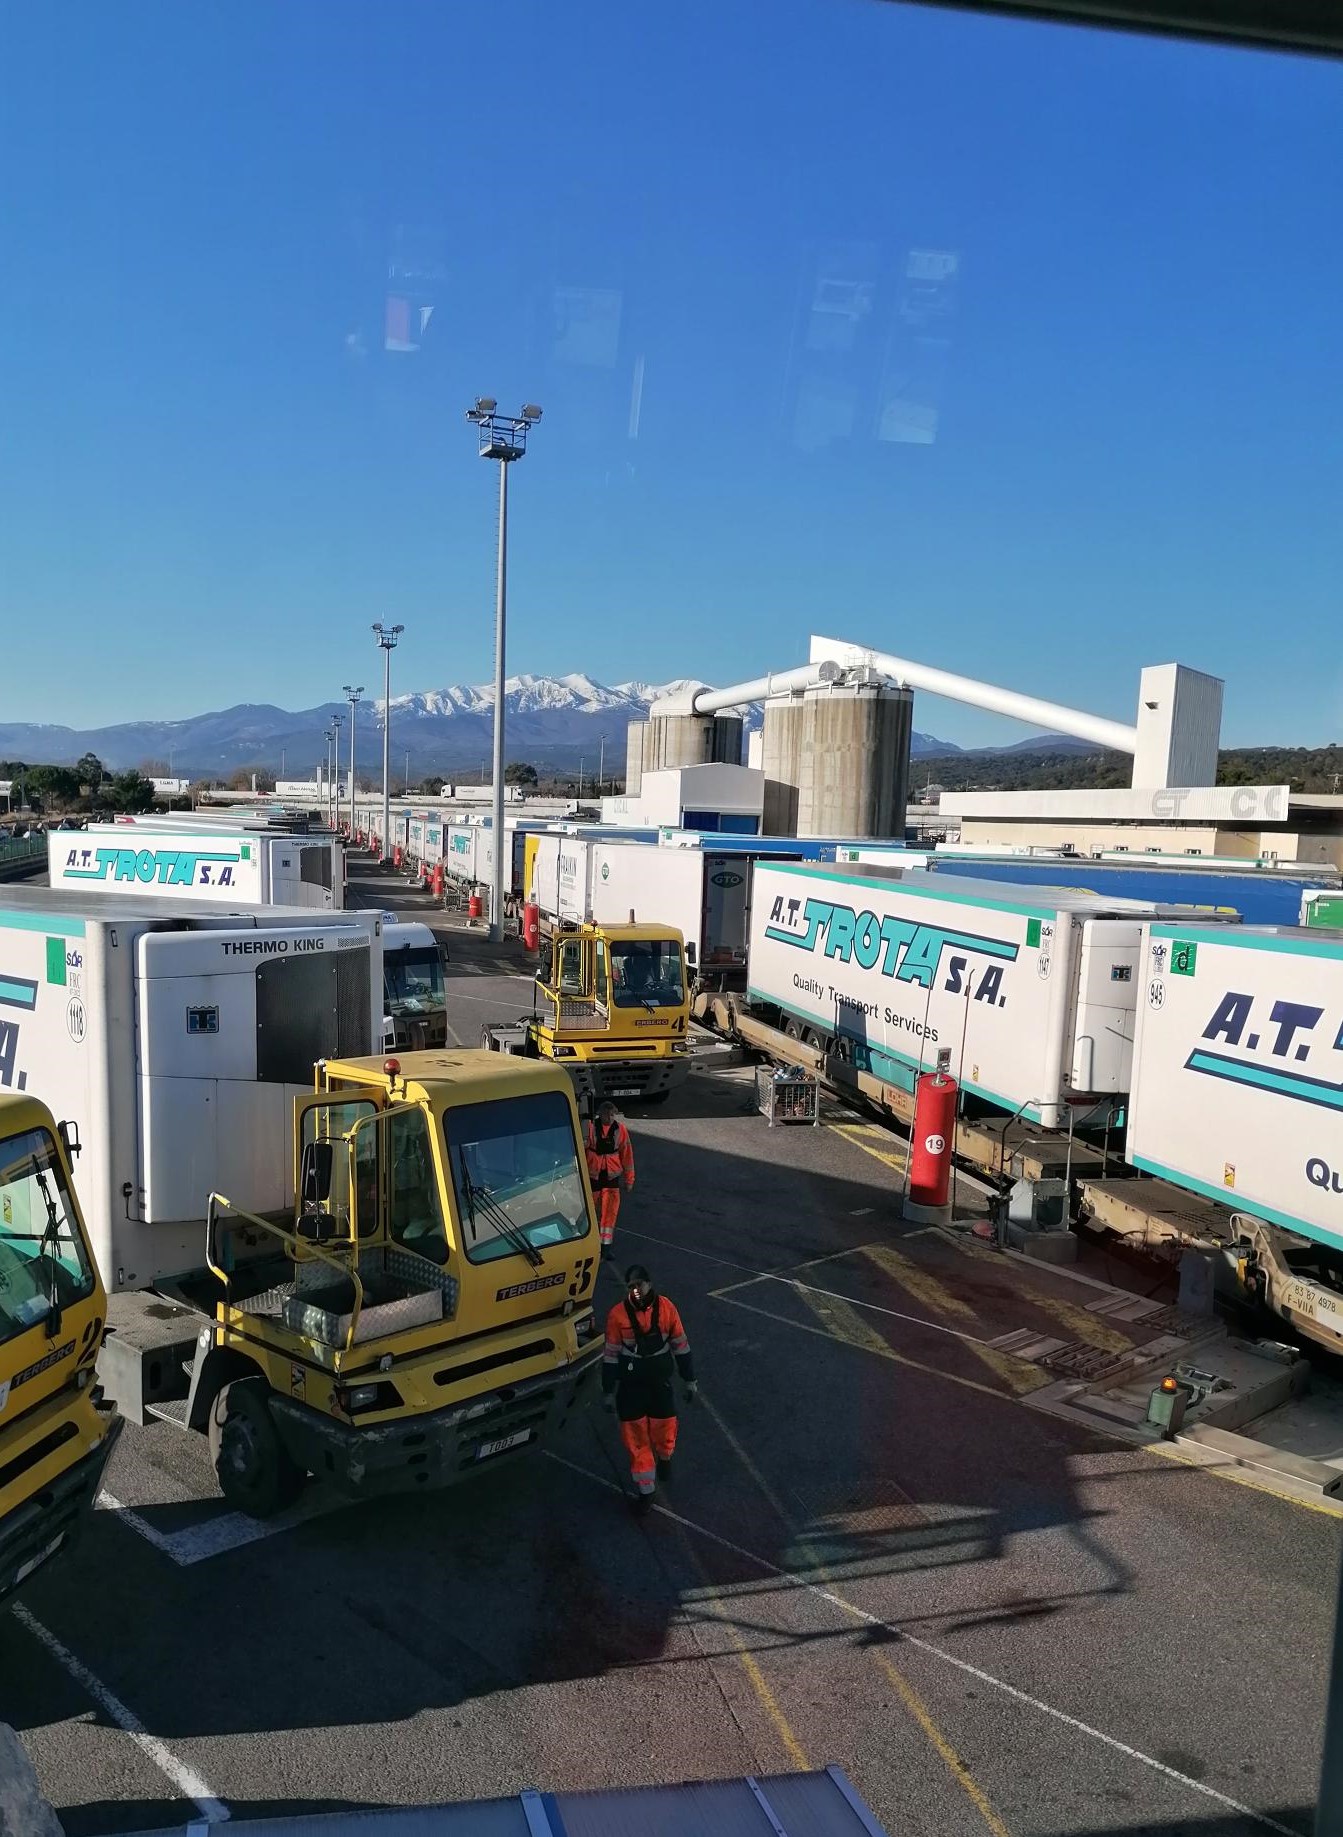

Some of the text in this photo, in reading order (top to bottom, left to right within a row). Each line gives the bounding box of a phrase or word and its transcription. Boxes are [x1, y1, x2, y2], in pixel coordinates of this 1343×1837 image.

[66, 848, 236, 887] A.T. TROTA S.A.
[714, 875, 740, 885] GTO
[221, 937, 325, 956] THERMO KING
[769, 895, 802, 928] A.T.
[803, 897, 944, 990] TROTA
[792, 972, 940, 1043] Quality Transport Services
[1150, 983, 1163, 1005] 945
[671, 1015, 685, 1033] 4
[1201, 991, 1325, 1062] A.T.
[926, 1138, 944, 1150] 19
[500, 1256, 594, 1300] TERBERG 3
[14, 1316, 102, 1387] TERBERG 2
